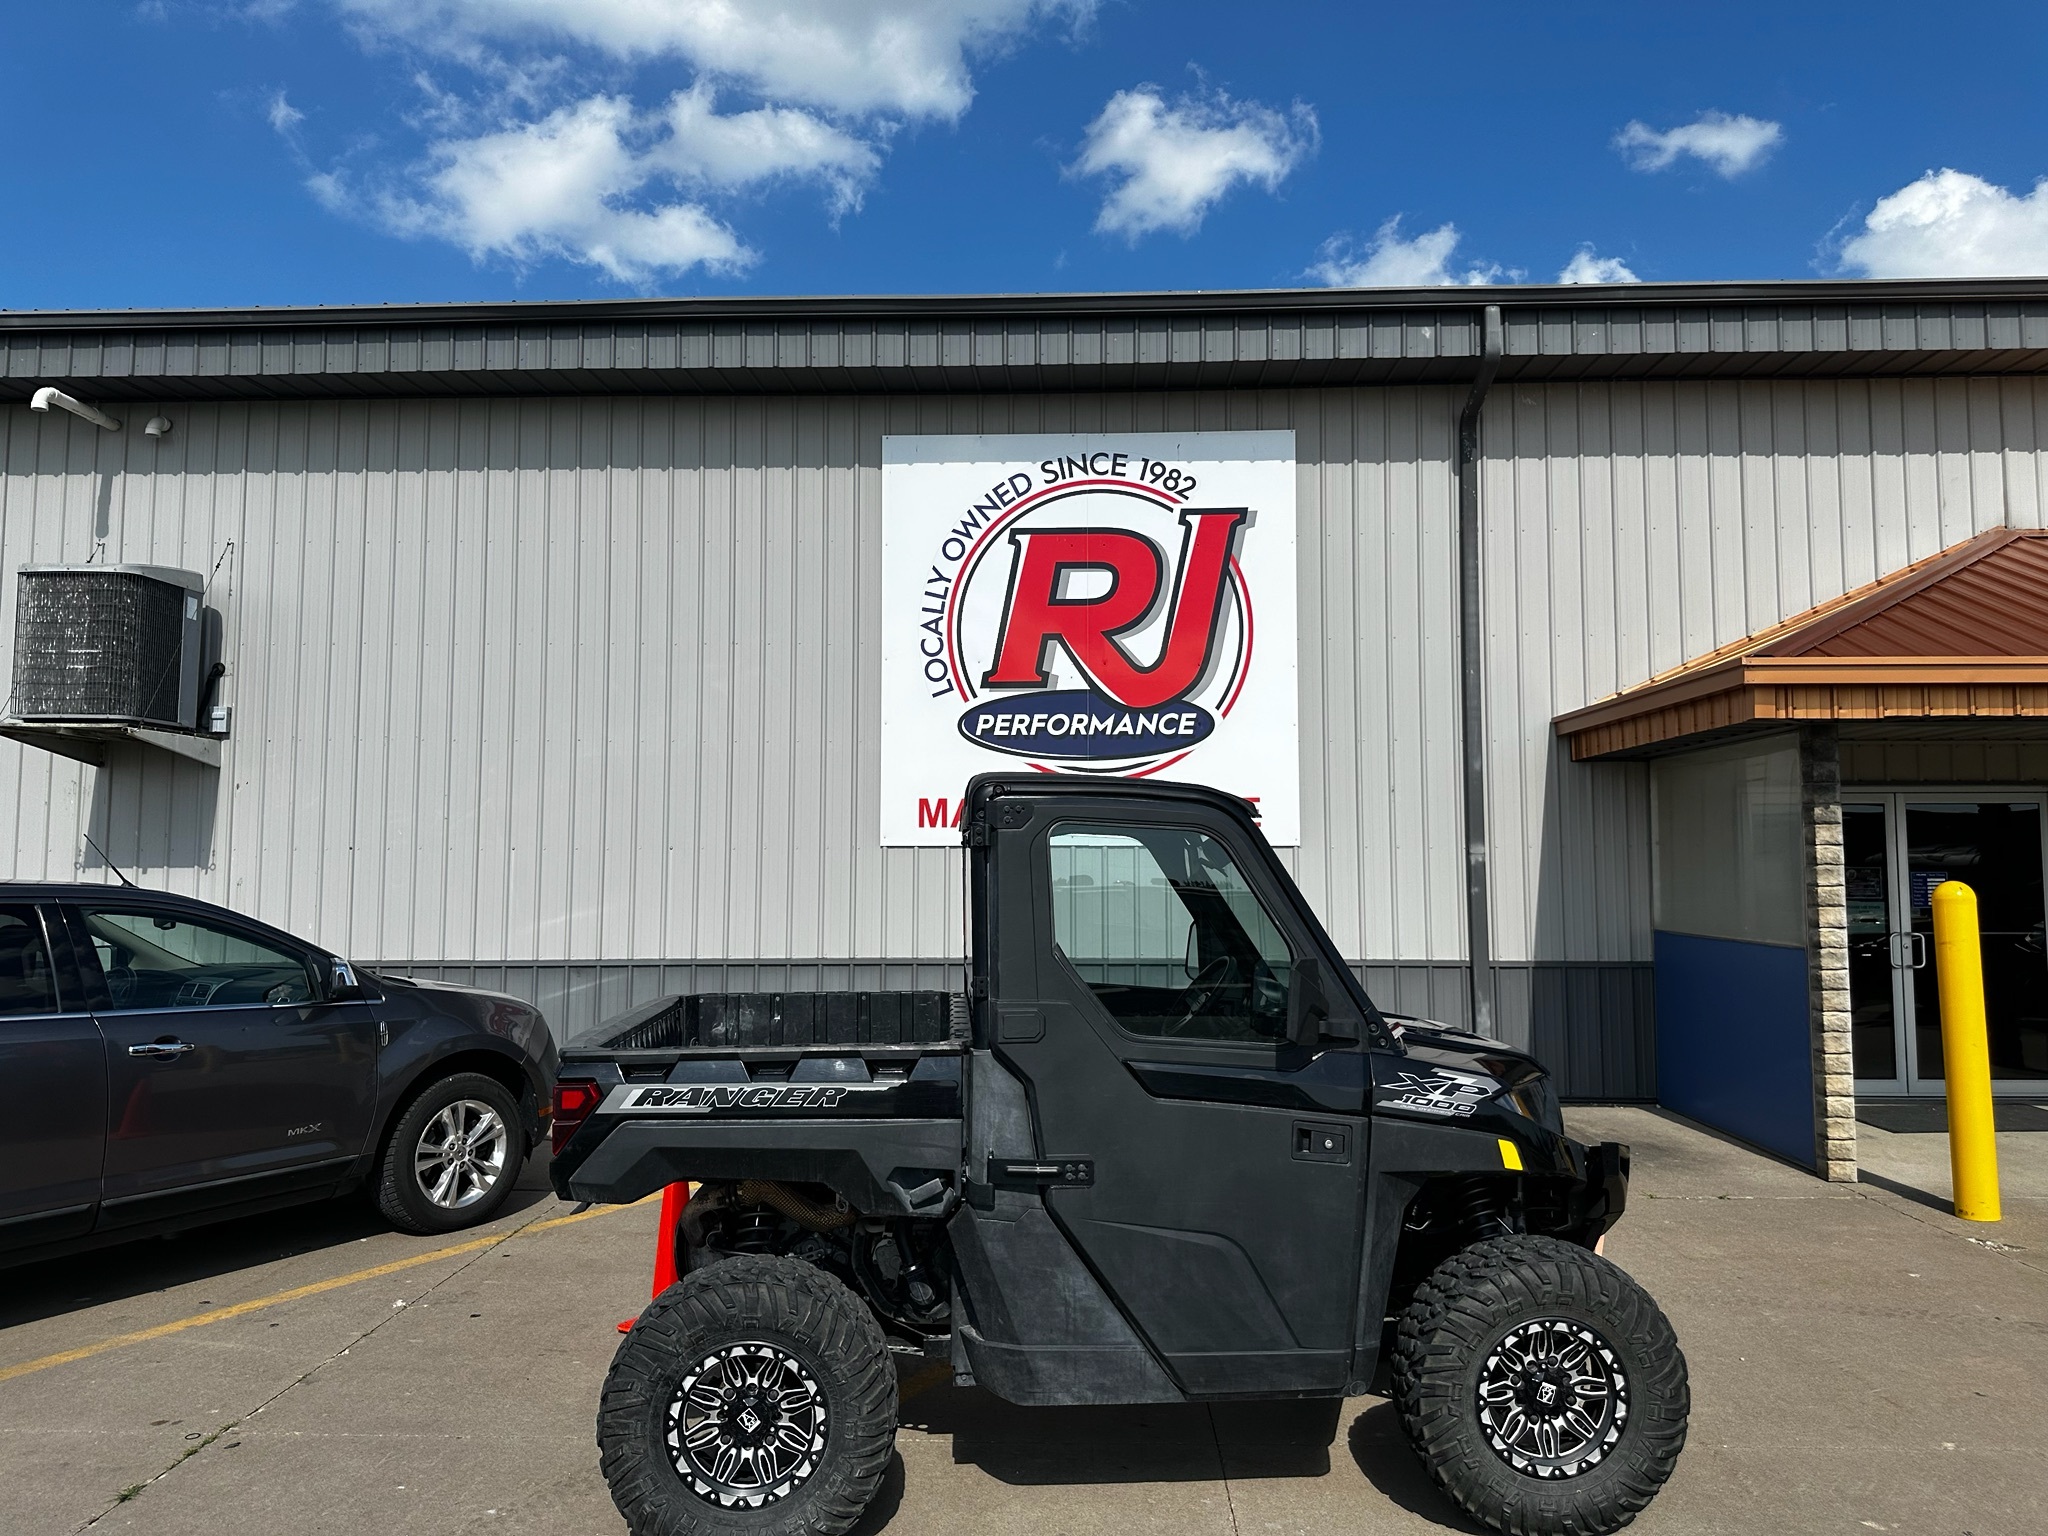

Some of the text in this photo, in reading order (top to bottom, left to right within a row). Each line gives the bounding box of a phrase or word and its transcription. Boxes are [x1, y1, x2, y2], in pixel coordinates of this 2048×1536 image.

[920, 452, 1197, 698] LOCALLY OWNED SINCE 1982
[980, 507, 1249, 709] RJ
[974, 711, 1198, 738] PERFORMANCE
[629, 1086, 848, 1108] RANGER
[1379, 1072, 1493, 1099] XP
[1401, 1093, 1477, 1115] 1000
[287, 1122, 322, 1137] MKX
